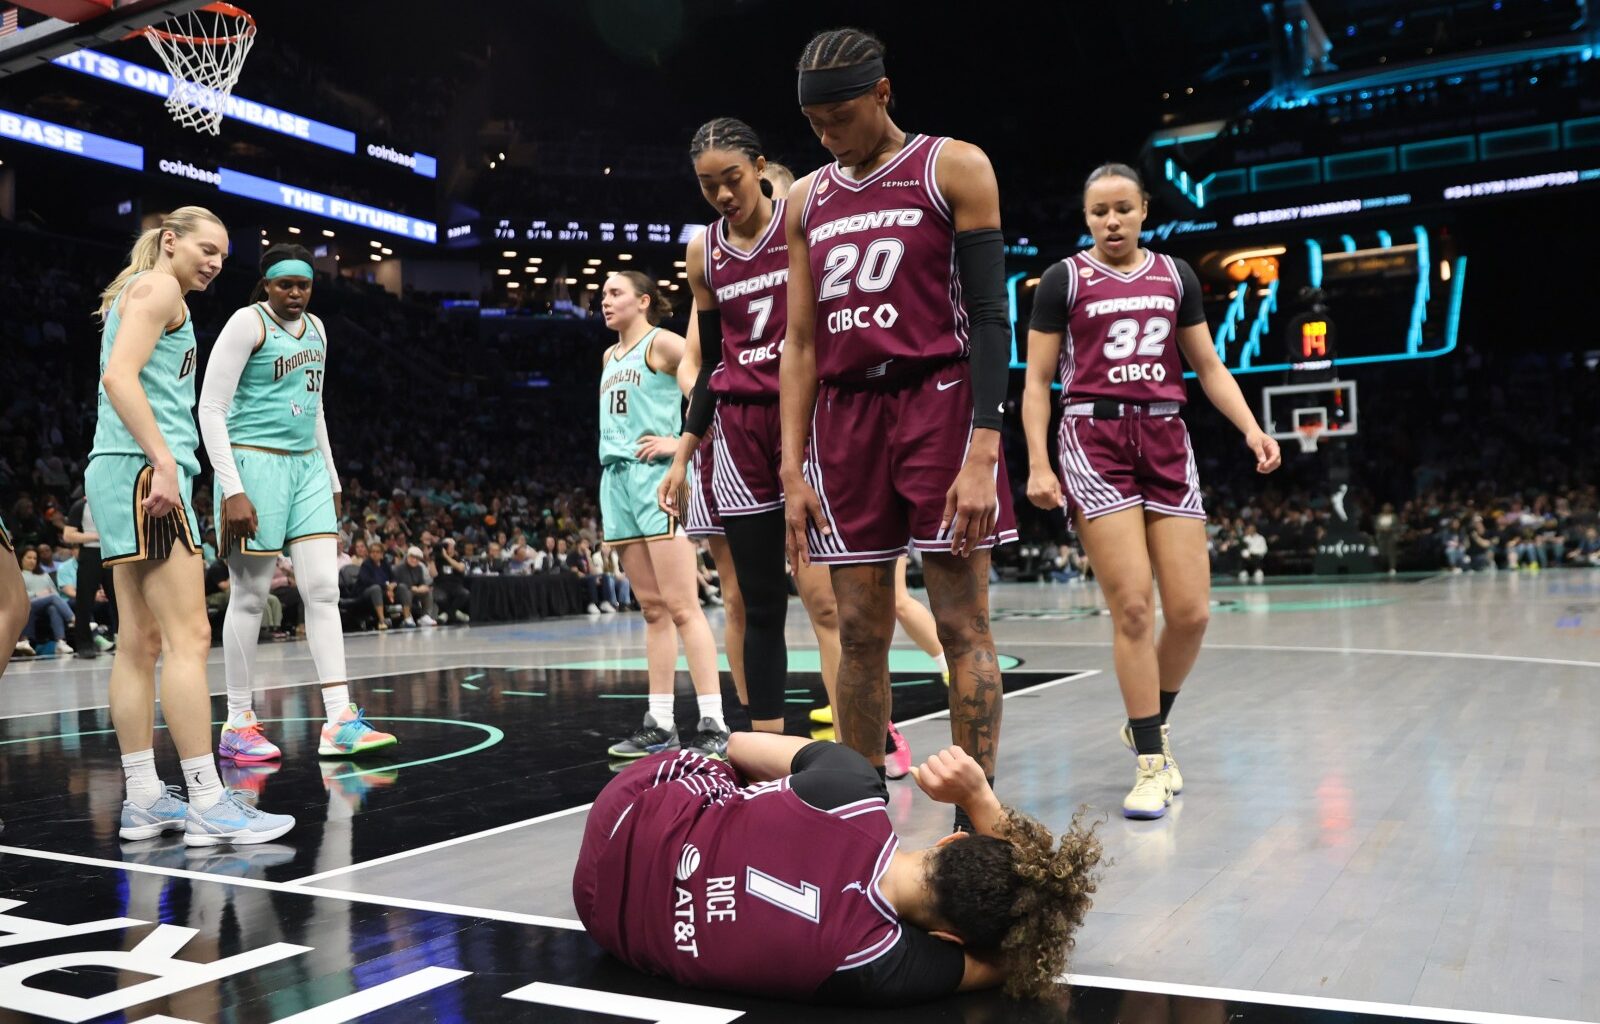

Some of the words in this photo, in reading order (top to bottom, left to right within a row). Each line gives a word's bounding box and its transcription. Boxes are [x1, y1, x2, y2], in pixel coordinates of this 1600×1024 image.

[124, 65, 169, 95] ON
[366, 143, 417, 169] coinbase
[158, 158, 222, 186] coinbase
[881, 179, 920, 188] SEPHORA
[279, 186, 324, 212] THE
[330, 199, 408, 235] FUTURE
[809, 208, 924, 248] TORONTO
[767, 244, 788, 254] SEPHO
[817, 237, 905, 302] 20
[716, 268, 790, 303] TORONT
[747, 295, 774, 341] 7
[827, 306, 871, 335] CIBC
[1085, 295, 1177, 319] TORONTO
[1103, 316, 1172, 361] 32
[738, 342, 778, 366] CIBC
[1107, 364, 1152, 384] CIBC
[609, 389, 629, 415] 18
[706, 875, 737, 923] RICE
[745, 865, 821, 924] 1
[673, 886, 699, 959] AT&T
